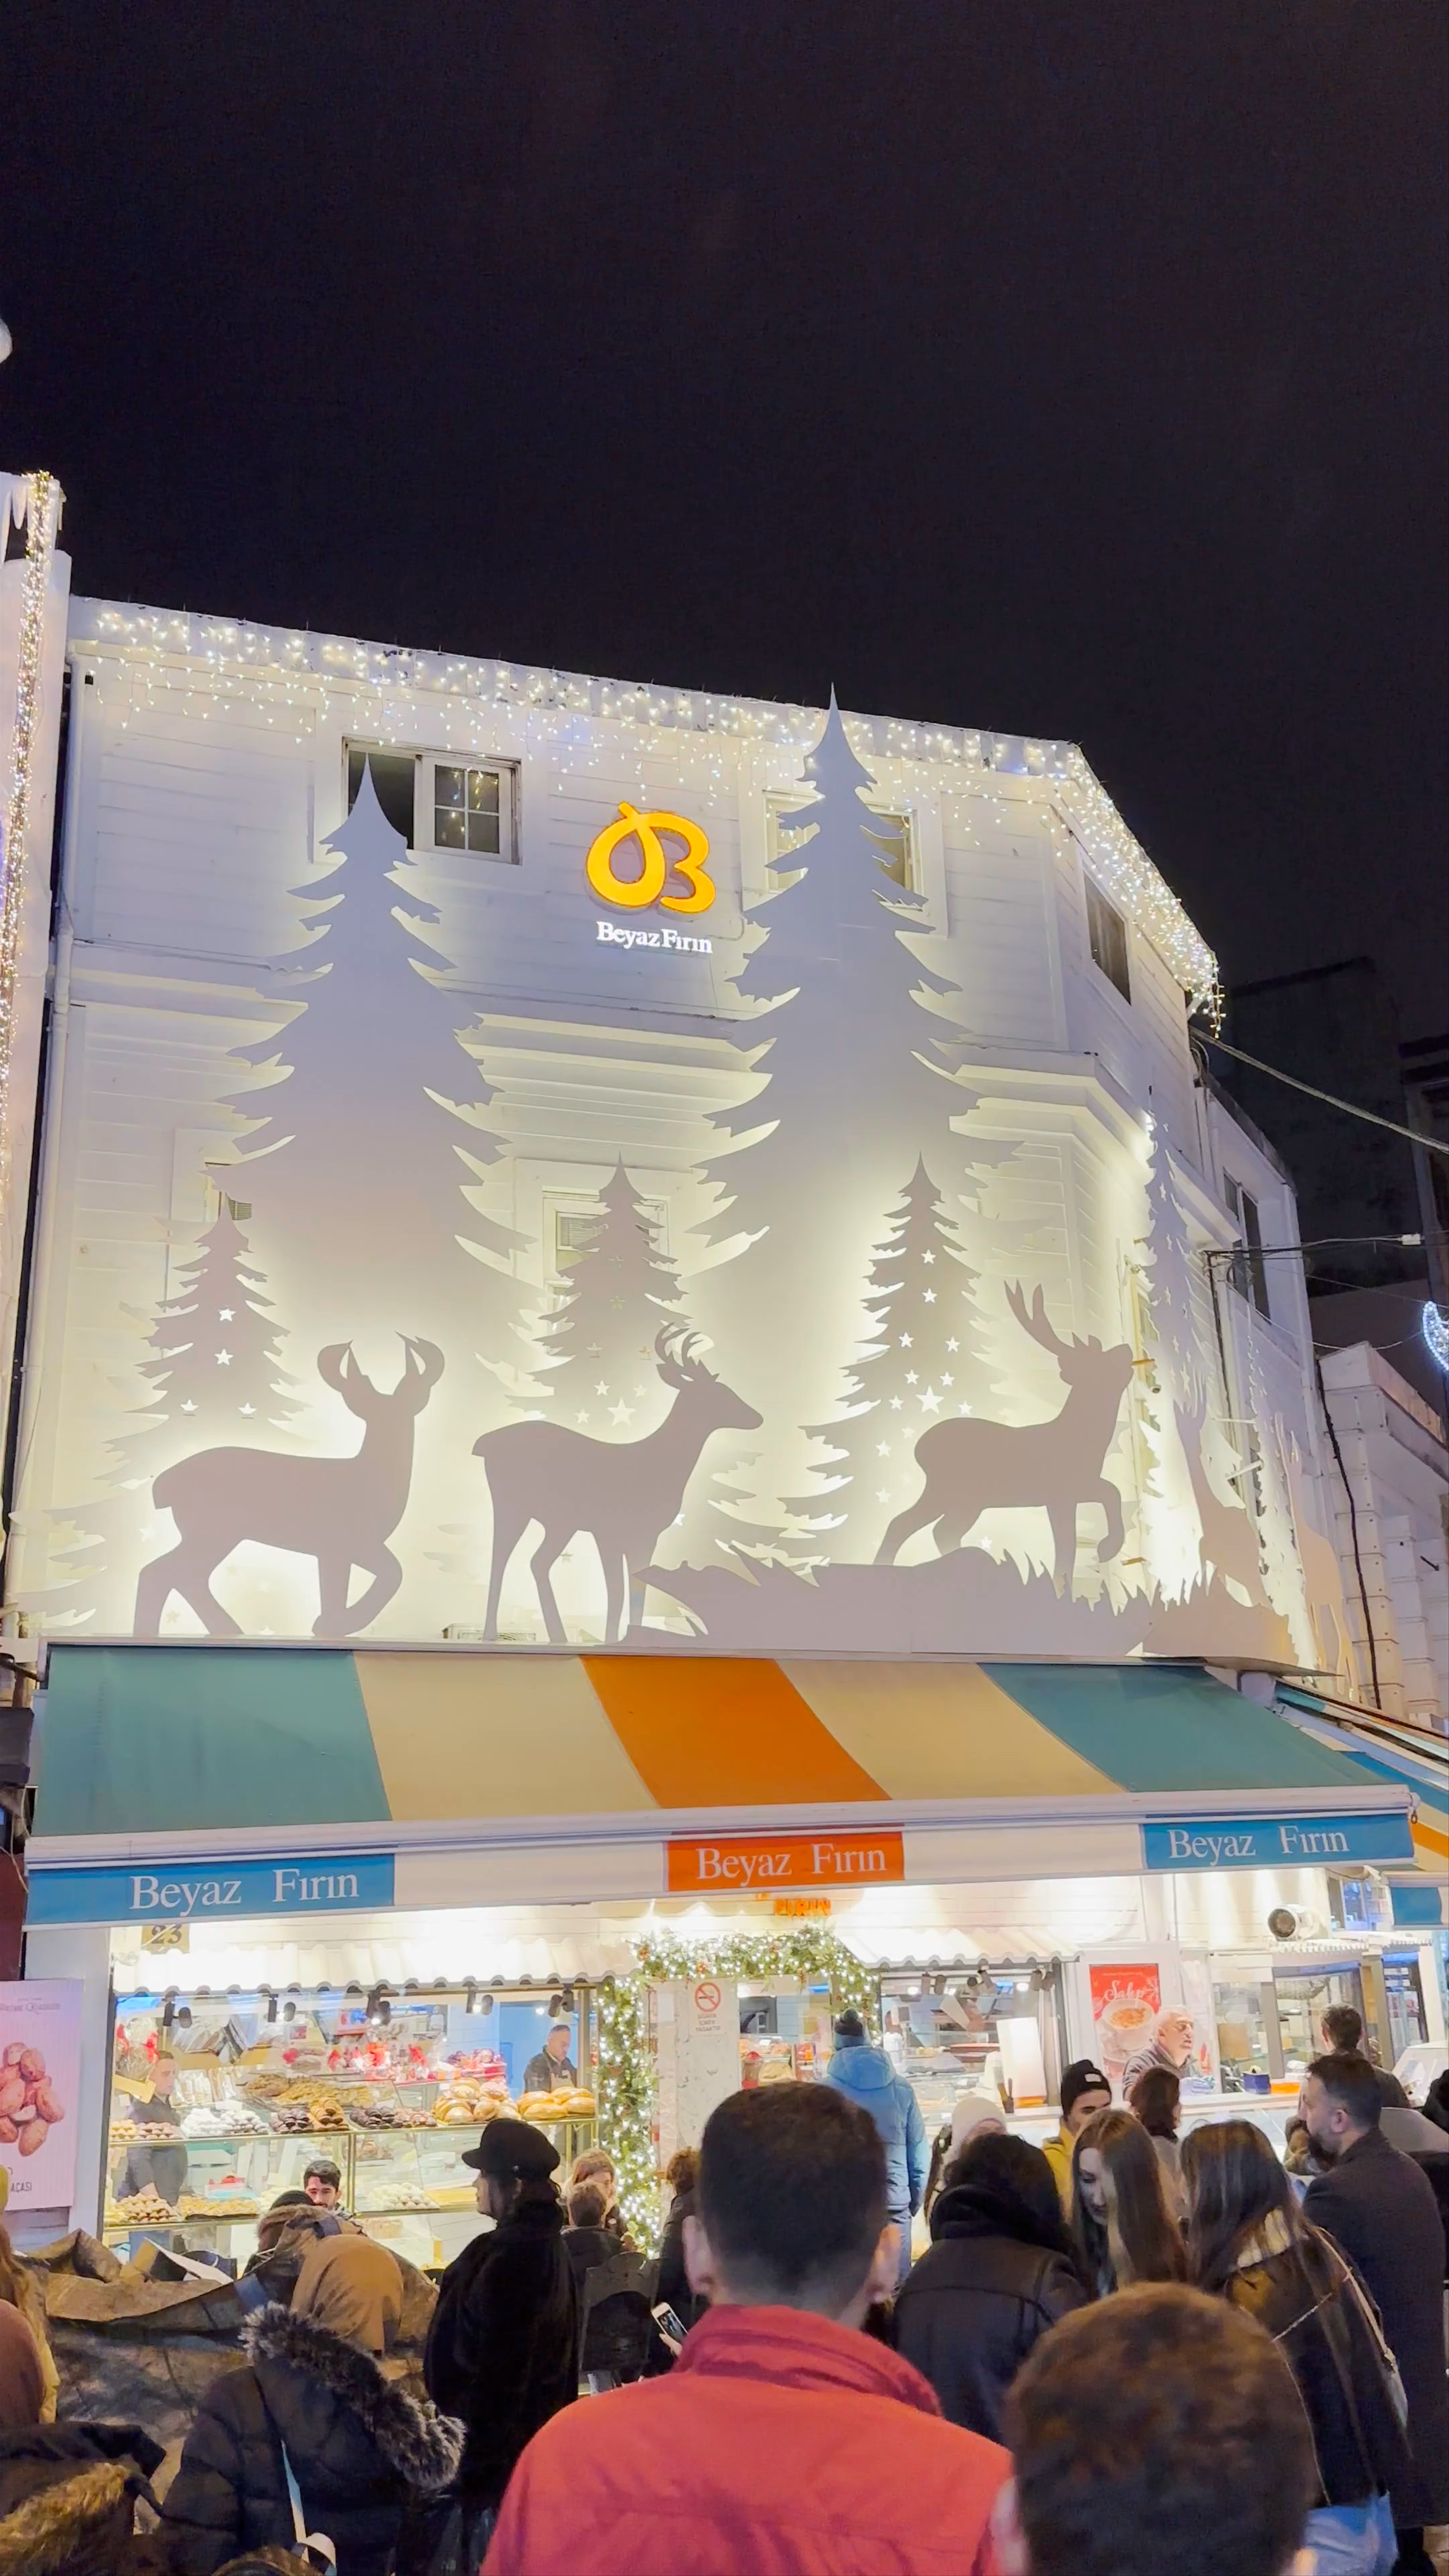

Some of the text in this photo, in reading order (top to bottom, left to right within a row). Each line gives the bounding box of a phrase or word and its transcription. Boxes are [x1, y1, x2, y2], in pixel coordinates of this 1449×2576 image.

[596, 921, 713, 954] Beyaz Fırın
[696, 1843, 886, 1887] Beyaz Fırın
[1167, 1825, 1350, 1866] Beyaz Fırın
[129, 1869, 359, 1916] Beyaz Fırın
[152, 1923, 182, 1944] 23
